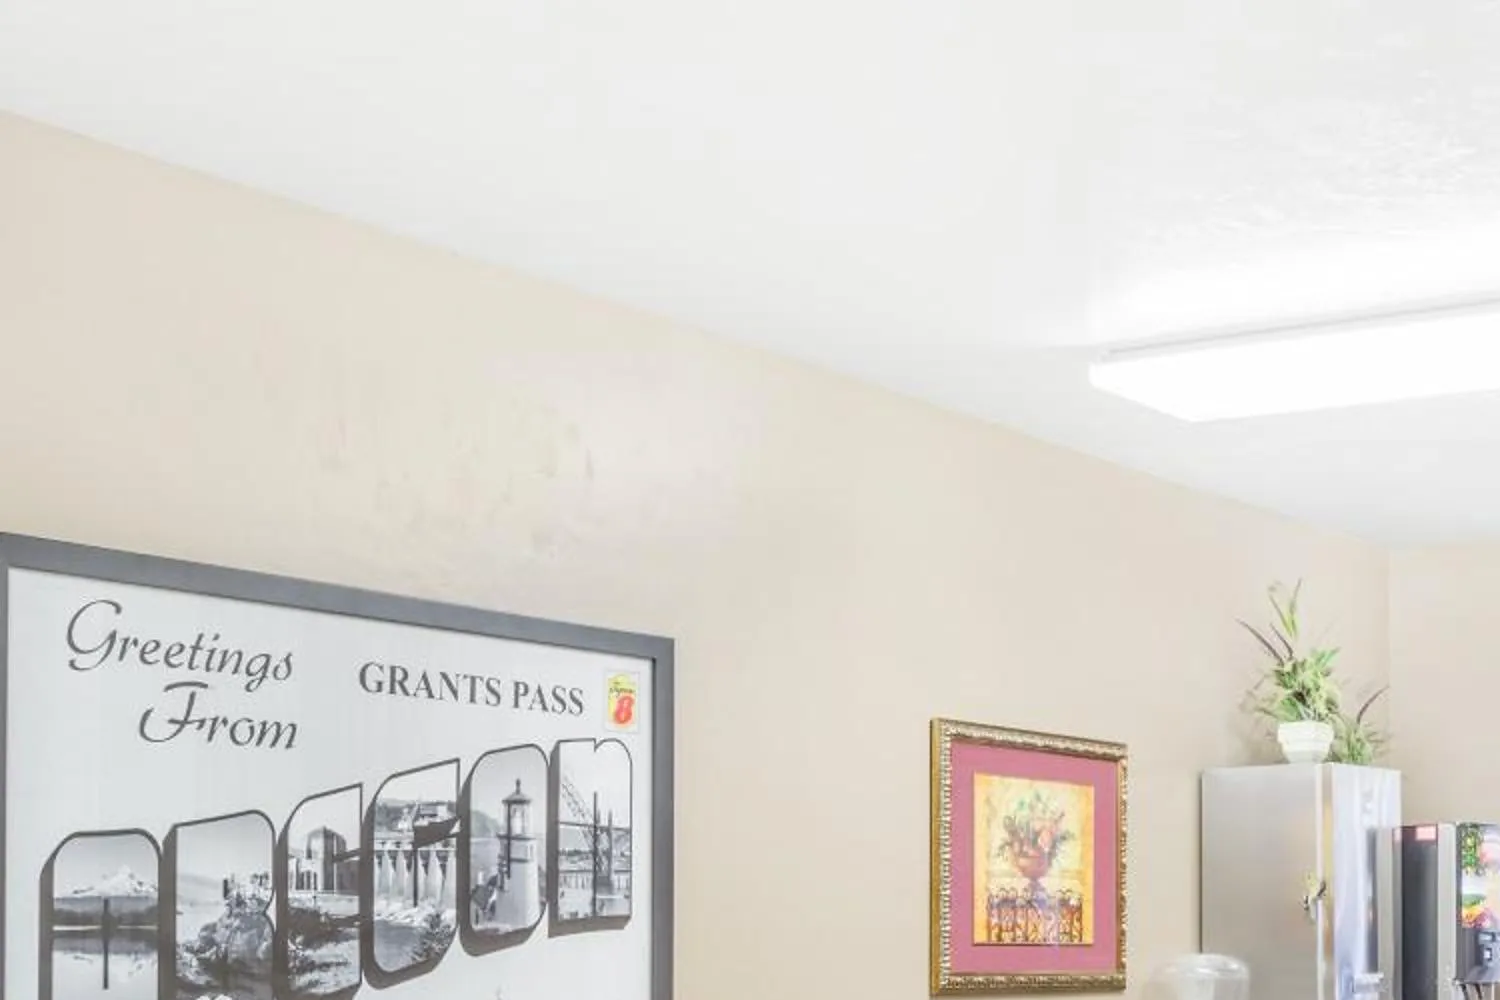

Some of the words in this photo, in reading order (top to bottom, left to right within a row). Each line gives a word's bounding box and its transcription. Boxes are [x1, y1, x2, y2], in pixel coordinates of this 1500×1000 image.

[66, 599, 293, 693] Greetings
[139, 681, 298, 749] From
[358, 661, 501, 707] GRANTS
[512, 680, 584, 716] PASS
